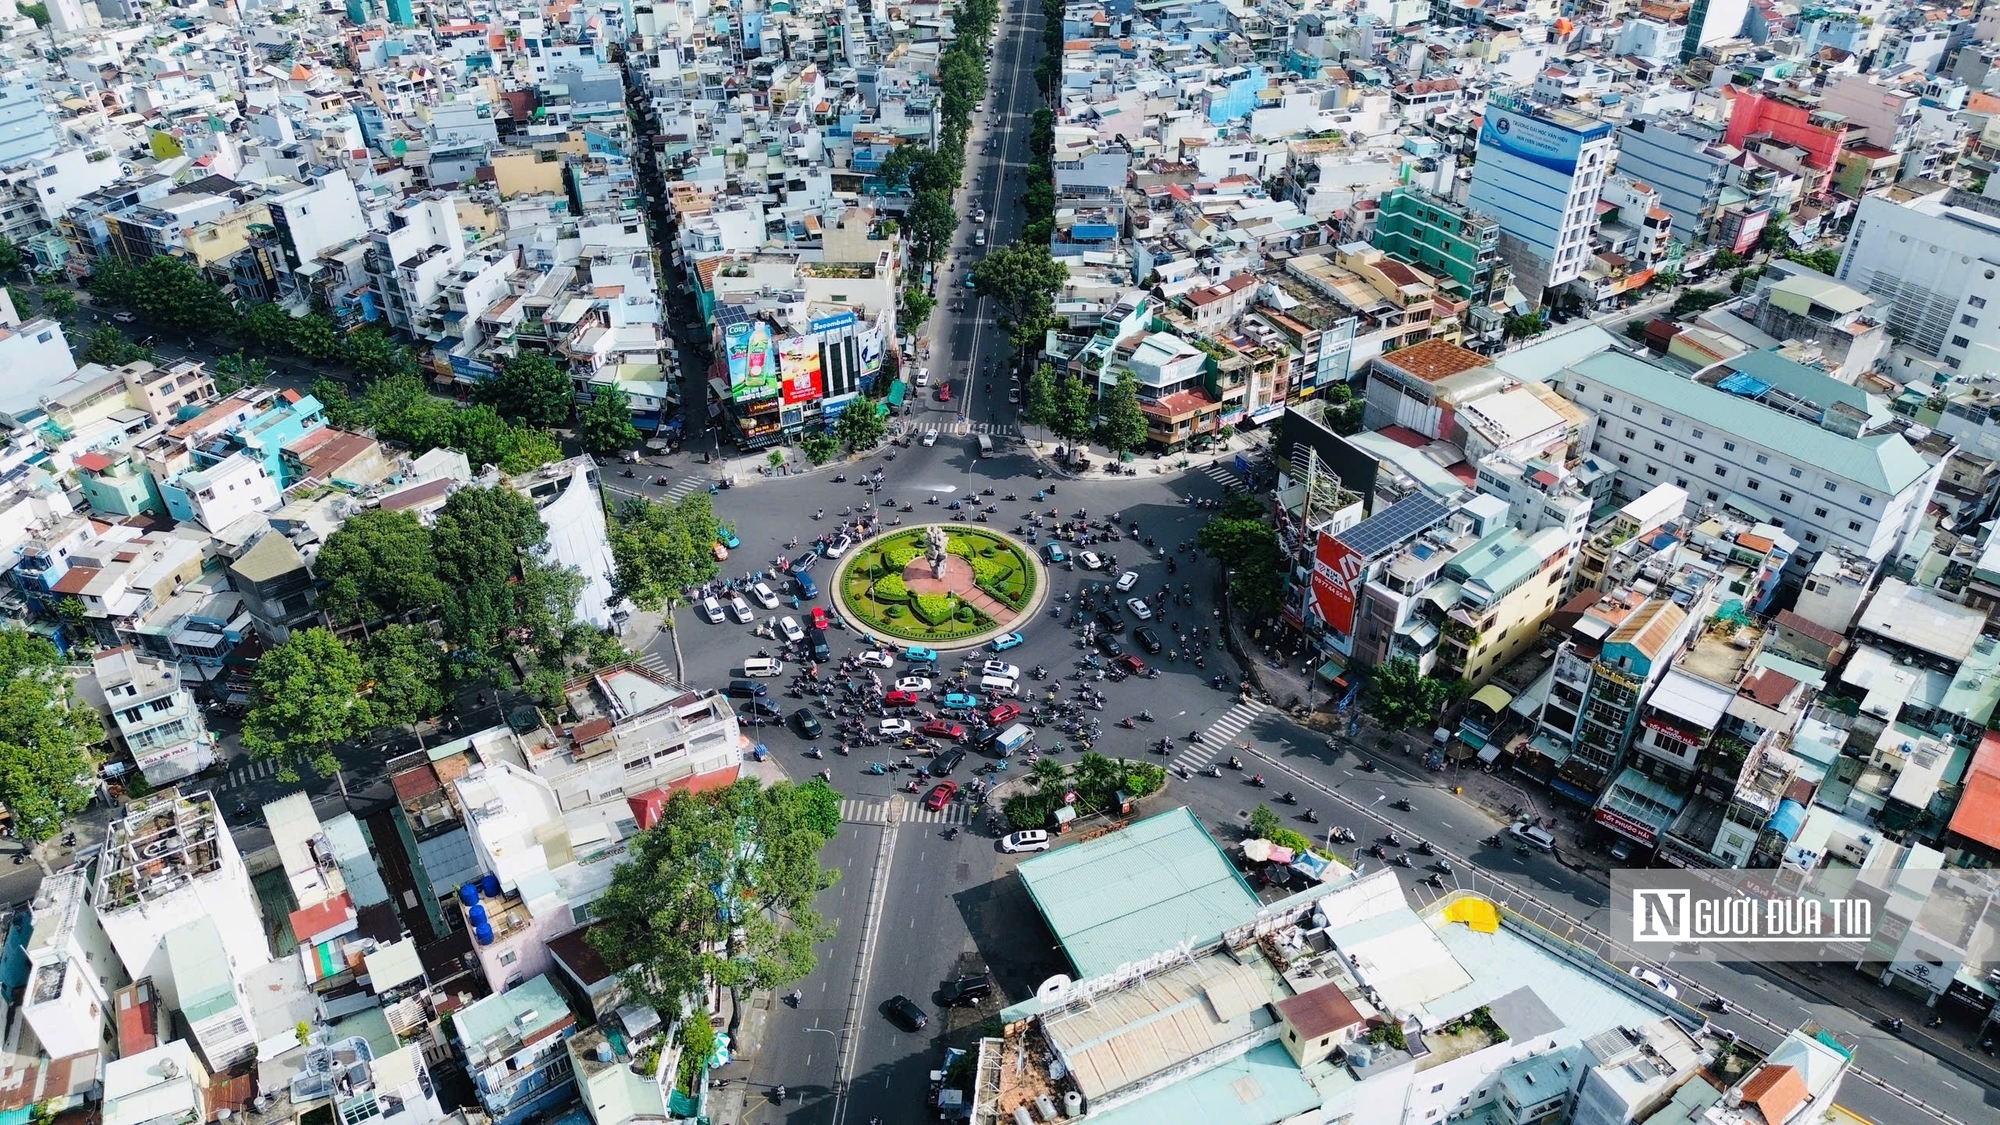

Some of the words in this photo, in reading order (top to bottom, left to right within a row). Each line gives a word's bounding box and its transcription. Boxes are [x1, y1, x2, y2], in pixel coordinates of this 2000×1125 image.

[729, 324, 747, 334] Cozy
[813, 316, 853, 331] Sacombank
[1602, 803, 1657, 832] BRIDGESTONE
